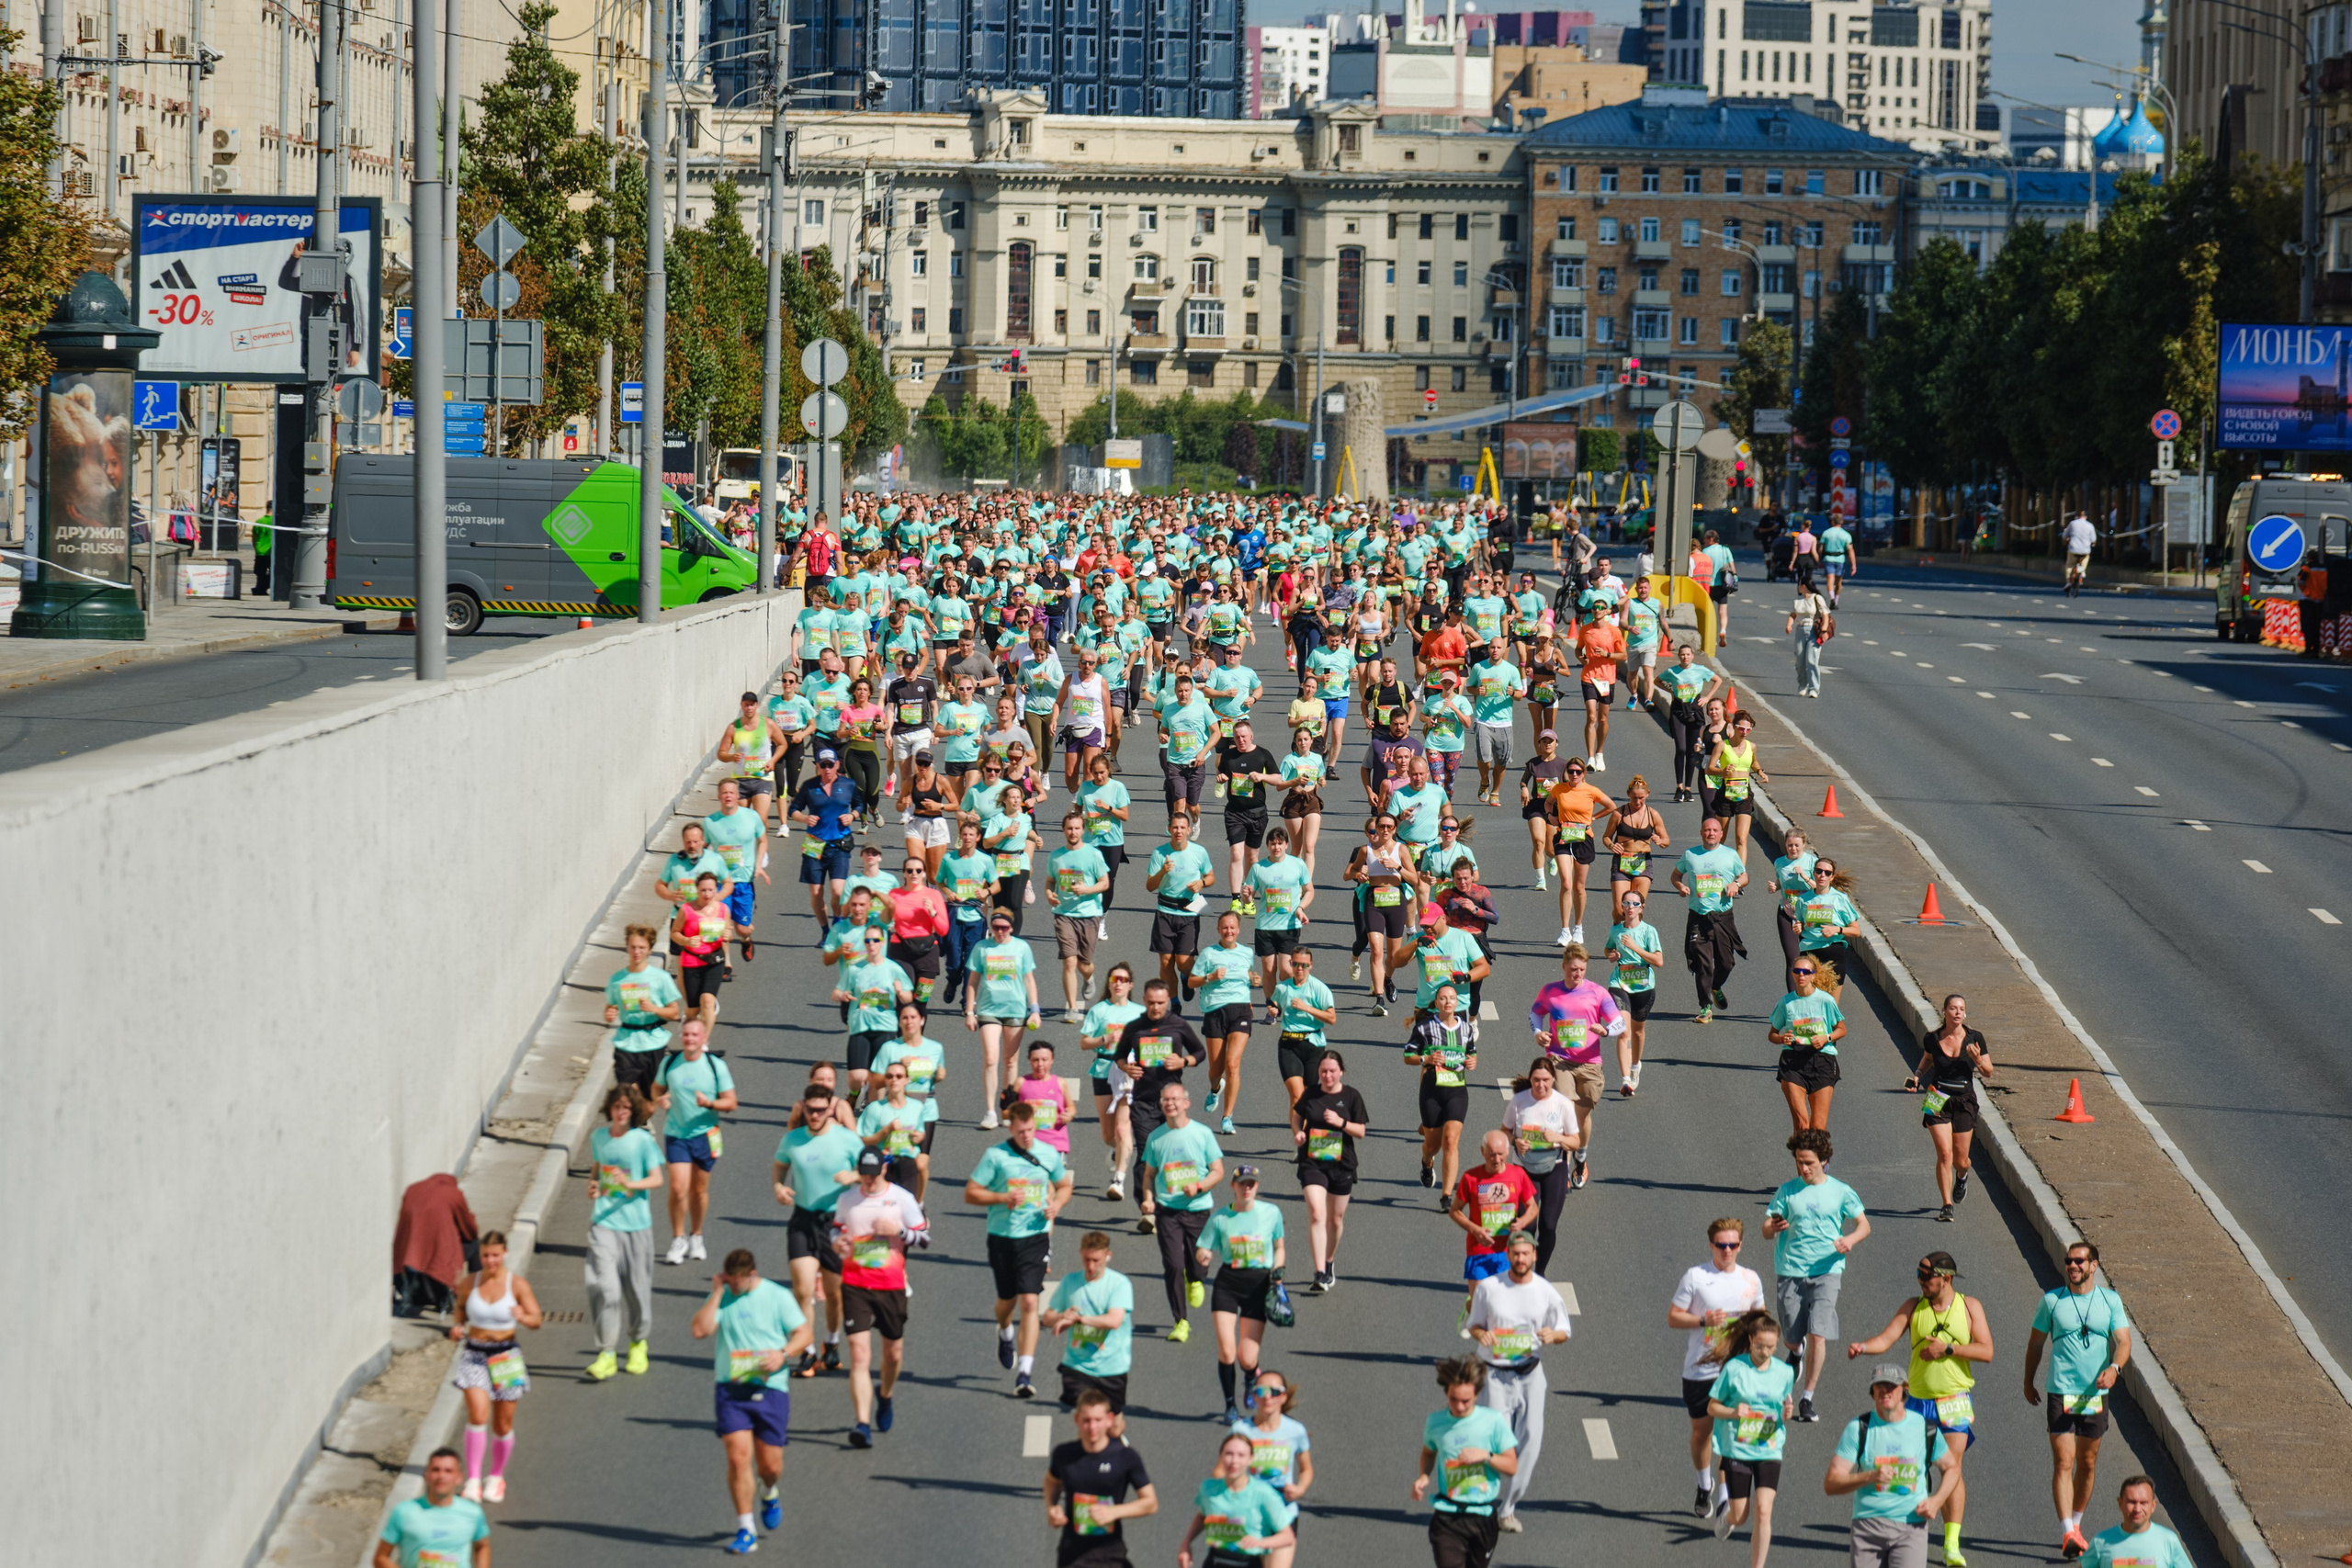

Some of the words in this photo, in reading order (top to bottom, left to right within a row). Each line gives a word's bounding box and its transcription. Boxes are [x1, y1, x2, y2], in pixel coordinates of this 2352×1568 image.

[232, 275, 254, 283] СТАРТ
[225, 285, 266, 293] ВНИМАНИЕ
[232, 295, 263, 303] ШКОЛА!
[252, 330, 291, 341] ОРИГИНАЛ
[2225, 408, 2271, 419] ВИДЕТЬ
[2272, 409, 2313, 422] ГОРОД
[2224, 420, 2233, 431] С
[2236, 418, 2279, 432] НОВОЙ
[2224, 433, 2277, 444] ВЫСОТЫ
[444, 502, 472, 513] ужба
[445, 515, 505, 526] плуатации
[55, 525, 126, 540] ДРУЖИТЬ
[1073, 700, 1093, 709] 69952
[1562, 829, 1584, 837] 69420
[1622, 858, 1645, 866] 70987
[1697, 880, 1723, 888] 65963
[1267, 895, 1291, 903] 68784
[1427, 963, 1452, 971] 78985
[1621, 971, 1646, 980] 69495
[1558, 1027, 1585, 1037] 69549
[1797, 1024, 1824, 1033] 69304
[1142, 1044, 1170, 1055] 65140
[1498, 1337, 1530, 1348] 70945
[1939, 1399, 1970, 1414] 80317
[1741, 1421, 1775, 1433] 66937
[1894, 1466, 1916, 1477] 146
